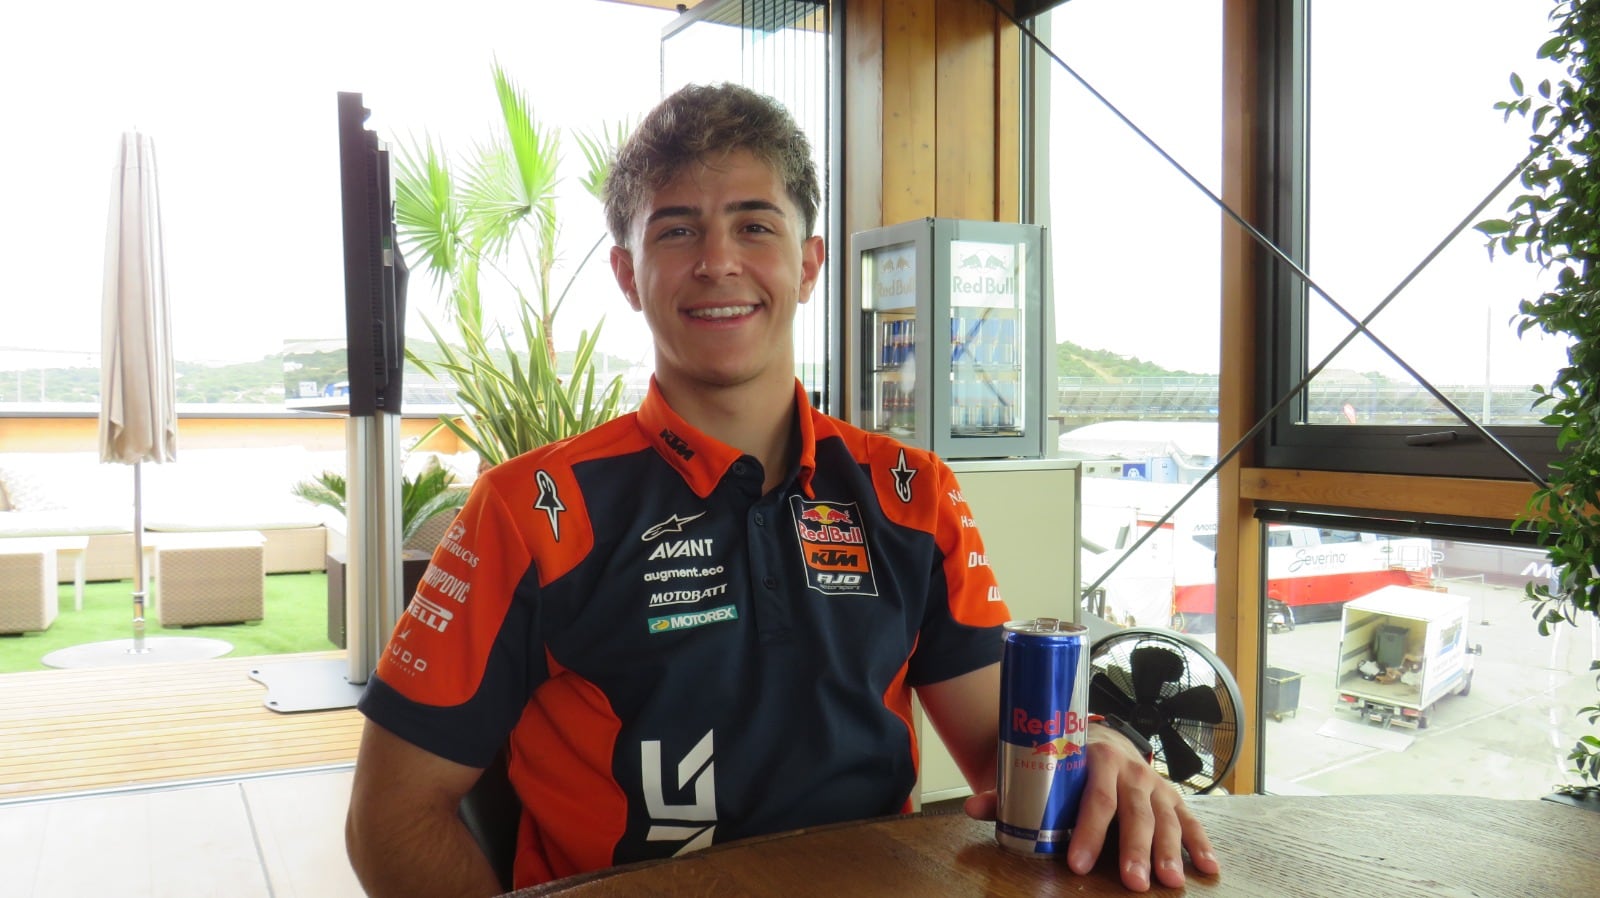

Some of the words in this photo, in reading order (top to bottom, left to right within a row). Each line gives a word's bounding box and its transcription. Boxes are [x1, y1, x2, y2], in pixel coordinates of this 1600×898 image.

[952, 276, 983, 294] Red
[985, 276, 1014, 295] Bull
[660, 428, 697, 462] KTM
[798, 520, 829, 542] Red
[830, 526, 864, 544] Bull
[648, 539, 714, 561] AVANT
[810, 549, 858, 567] KTM
[1288, 549, 1346, 573] Severino
[643, 566, 725, 583] augment.eco
[816, 573, 861, 585] AJO
[649, 583, 728, 607] MOTOBATT
[670, 608, 735, 629] MOTOREX
[1013, 708, 1060, 735] Red
[1013, 758, 1063, 772] ENERGY
